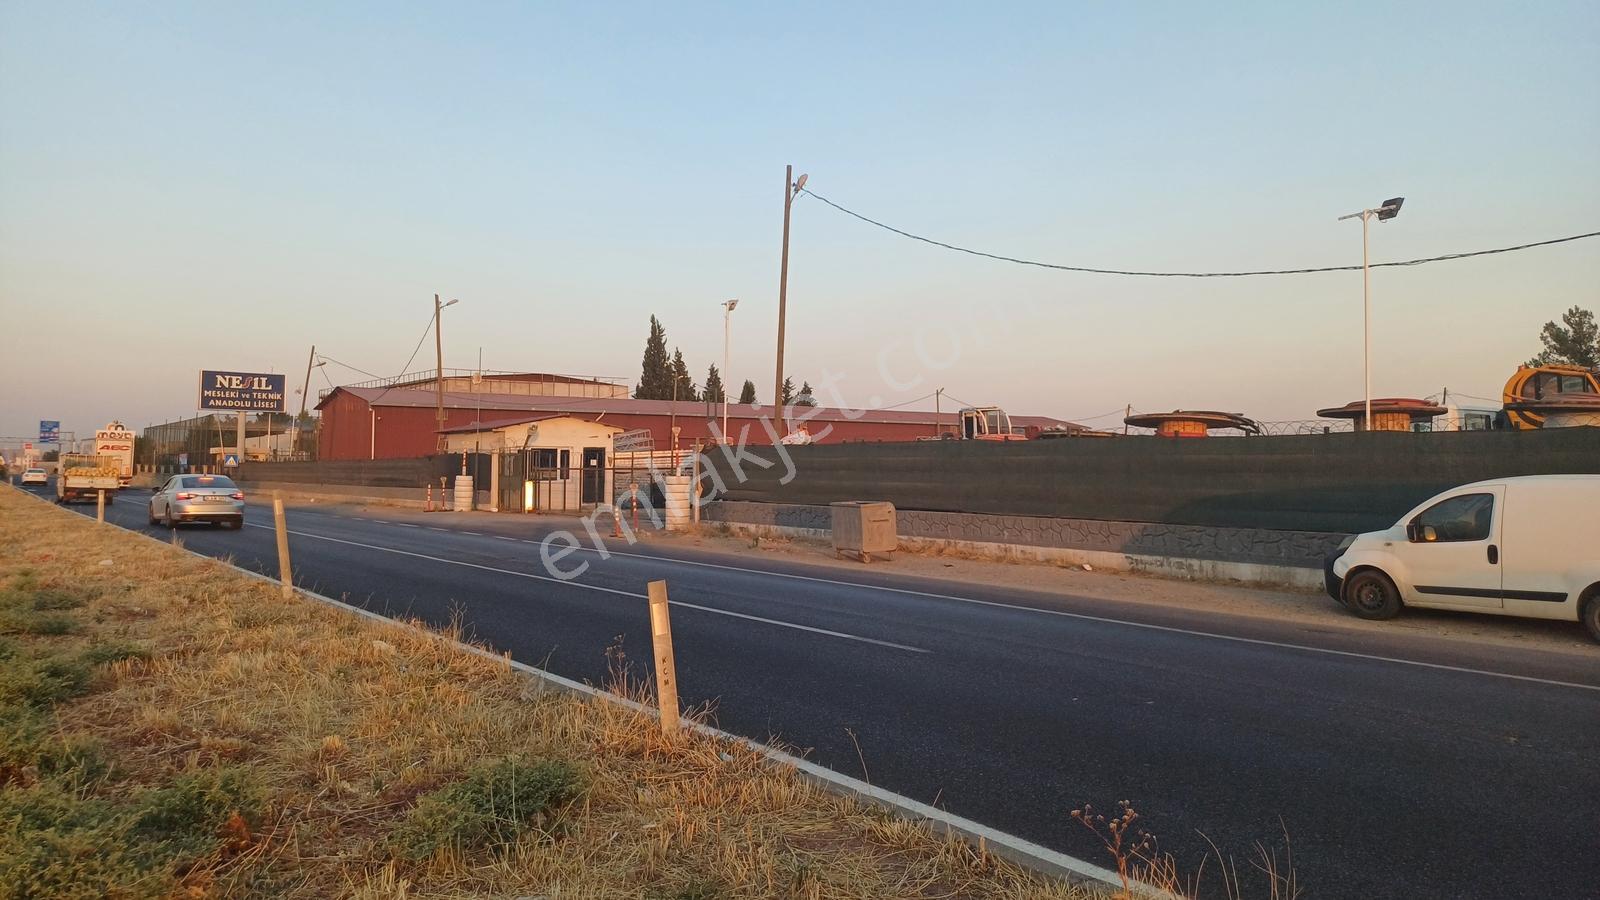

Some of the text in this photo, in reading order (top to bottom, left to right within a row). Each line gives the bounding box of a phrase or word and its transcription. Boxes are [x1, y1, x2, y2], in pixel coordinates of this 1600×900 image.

[204, 390, 239, 398] MESLEKİ
[252, 391, 282, 400] TEKNİK
[208, 399, 277, 409] ANADOLU LİSESİ
